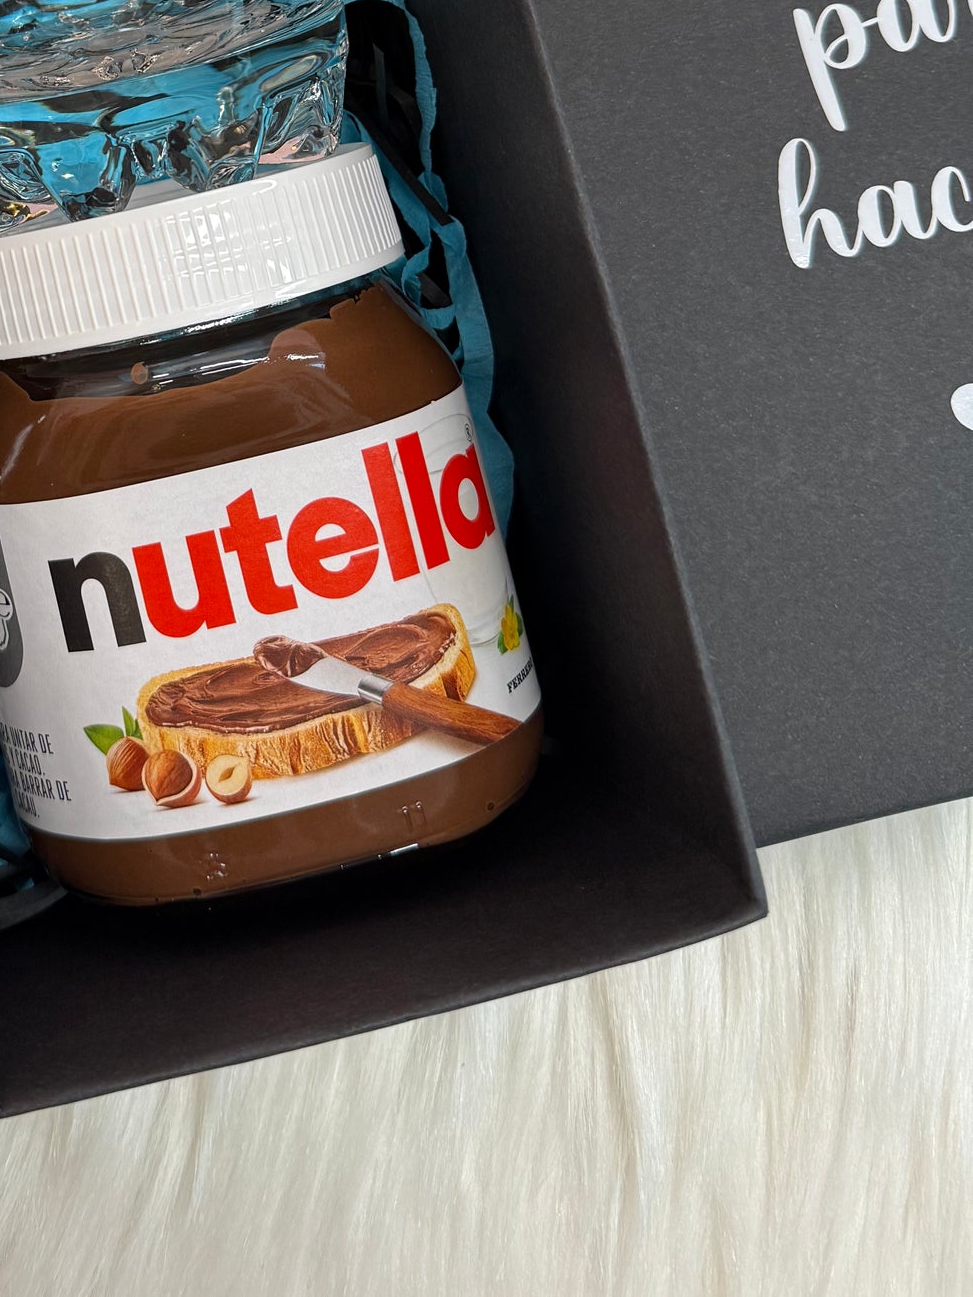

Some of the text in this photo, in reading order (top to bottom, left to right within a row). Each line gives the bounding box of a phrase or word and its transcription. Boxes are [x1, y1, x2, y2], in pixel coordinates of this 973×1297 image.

[48, 430, 497, 653] nutella
[38, 733, 53, 754] DE
[56, 781, 71, 801] DE
